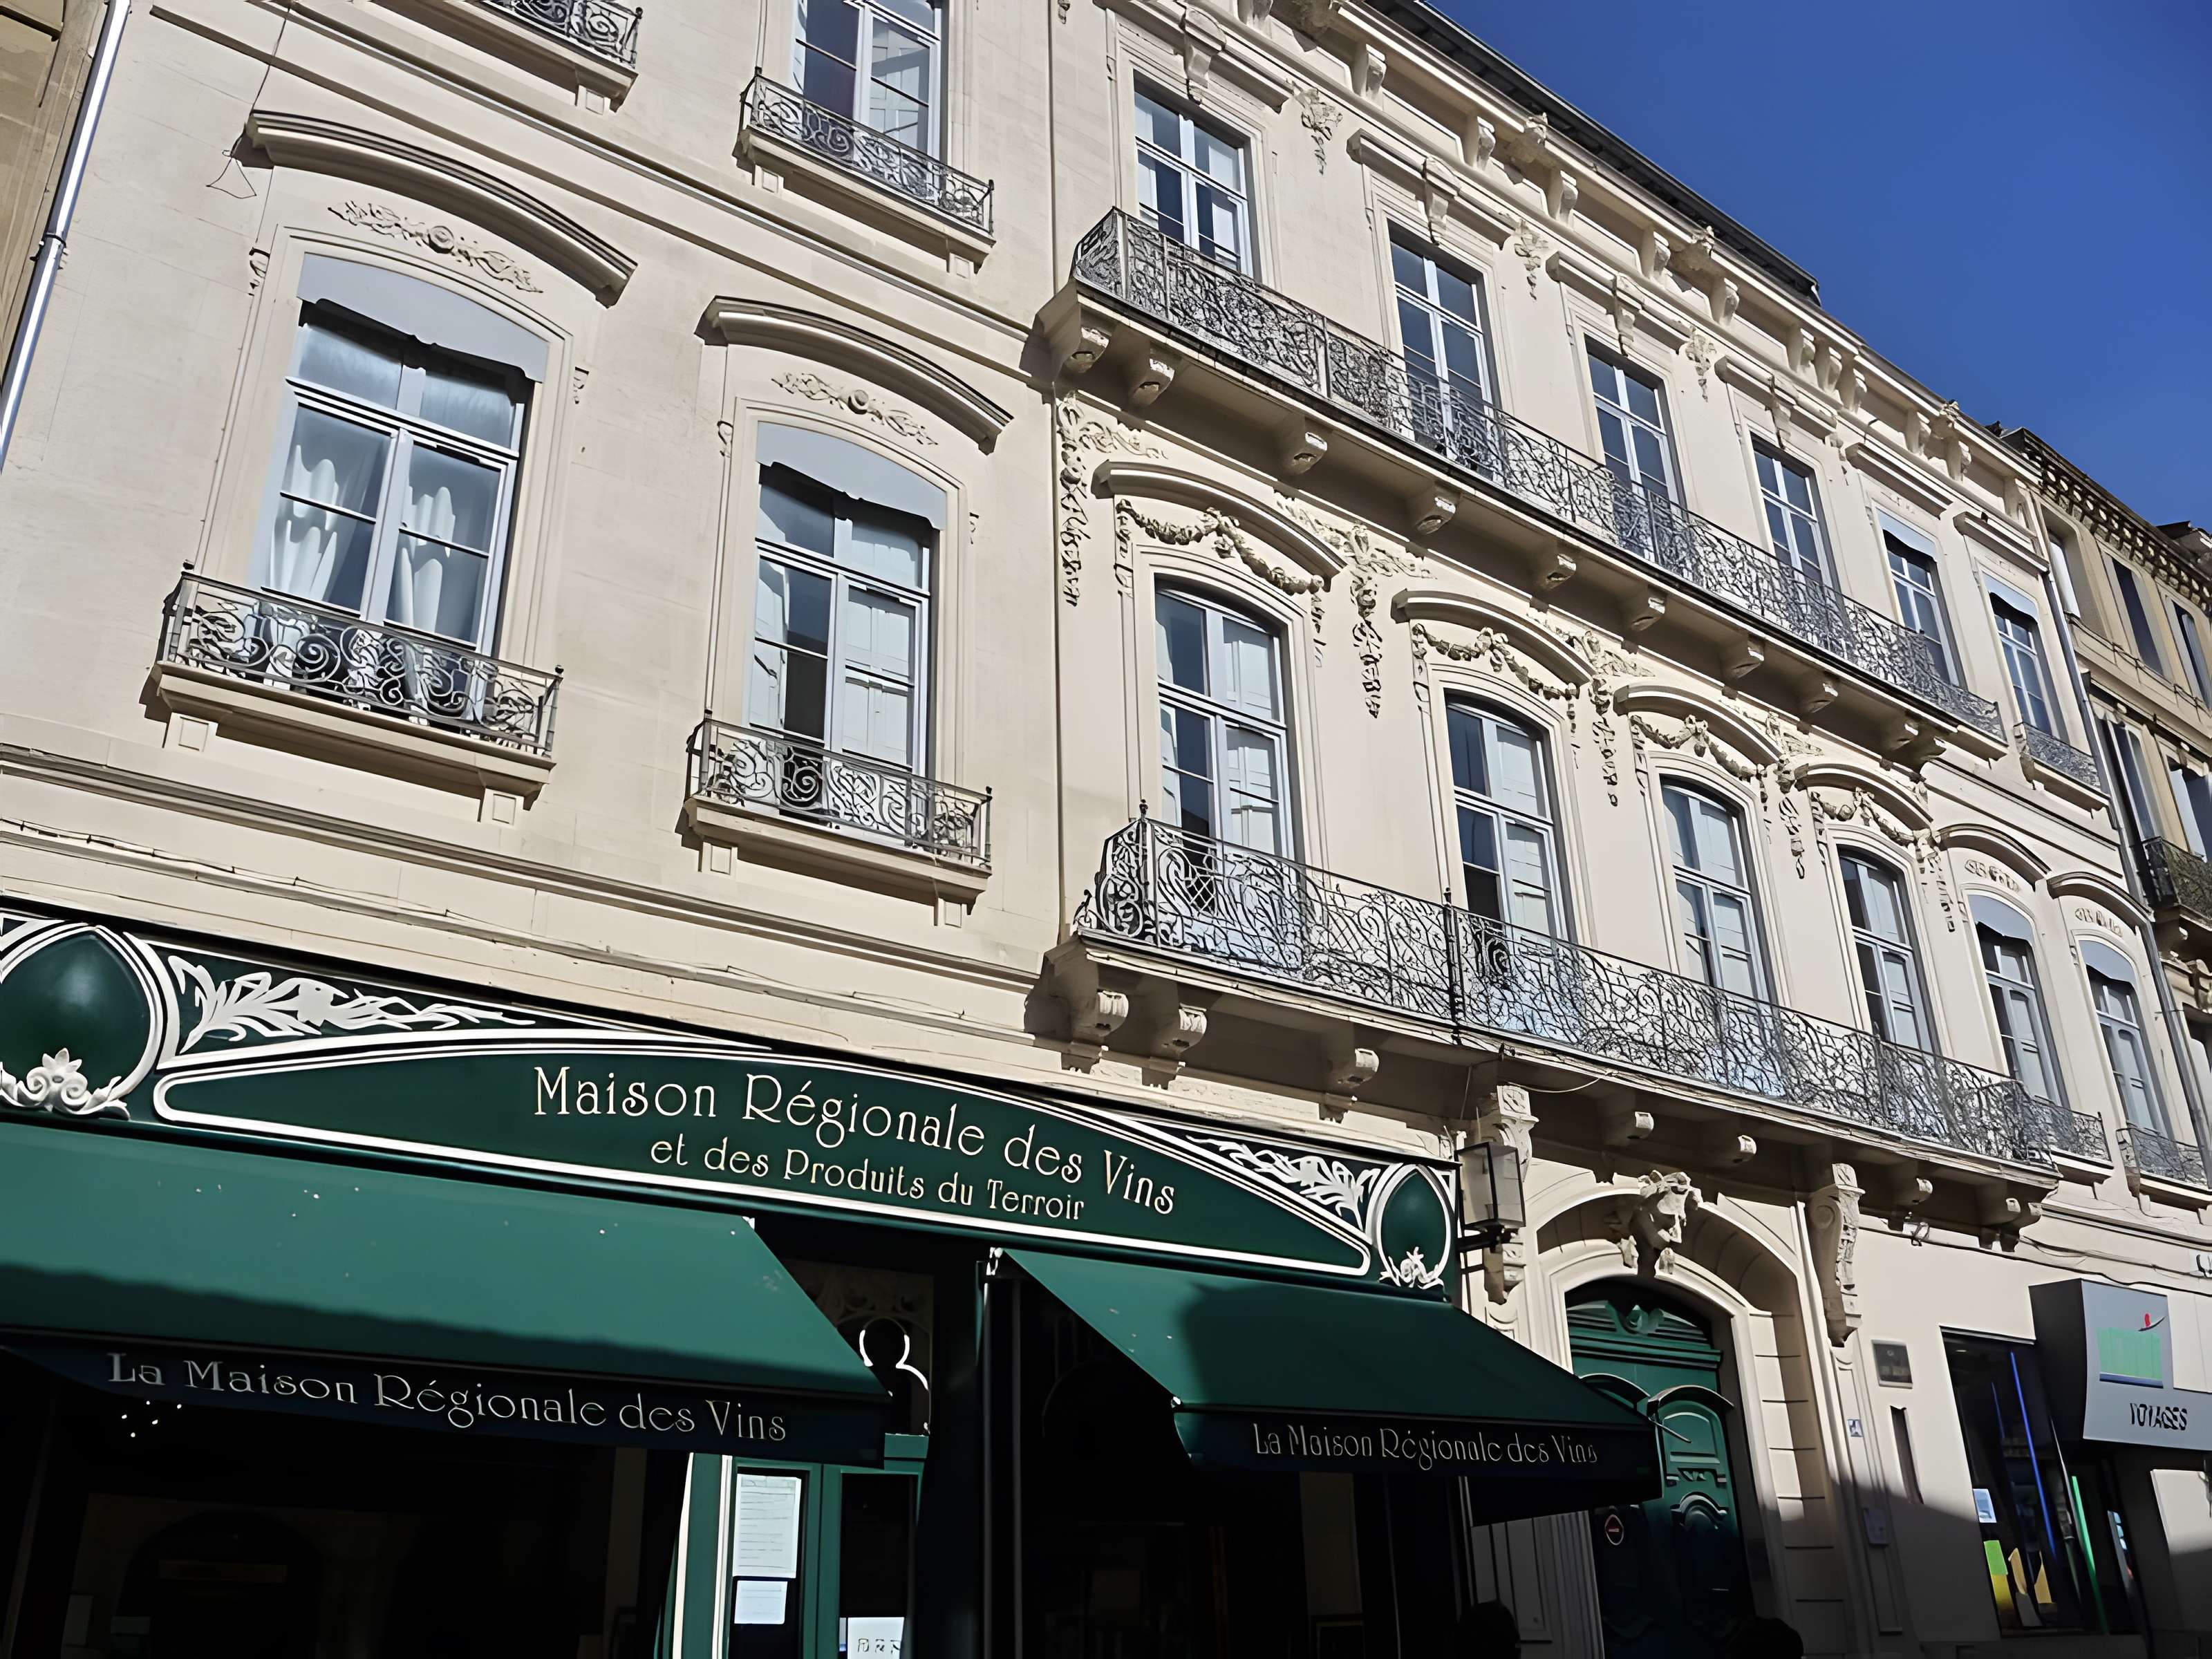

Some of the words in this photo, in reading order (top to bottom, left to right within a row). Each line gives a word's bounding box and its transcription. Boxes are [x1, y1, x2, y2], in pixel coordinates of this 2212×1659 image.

[534, 1066, 717, 1118] Maison
[742, 1073, 985, 1156] Régionale
[1004, 1123, 1082, 1183] des
[1103, 1150, 1174, 1215] Vins
[650, 1133, 688, 1166] et
[704, 1136, 769, 1177] des
[783, 1148, 924, 1199] Produits
[938, 1172, 973, 1206] du
[987, 1179, 1085, 1220] Terroir
[108, 1353, 166, 1385] La
[183, 1360, 358, 1404] Maison
[373, 1374, 606, 1429] Régionale
[619, 1392, 695, 1432] des
[705, 1399, 786, 1441] Vins
[1253, 1423, 1282, 1454] La
[1287, 1425, 1373, 1456] Maison
[1379, 1427, 1502, 1471] Régionale
[1507, 1432, 1549, 1463] des
[1551, 1434, 1598, 1463] Vins
